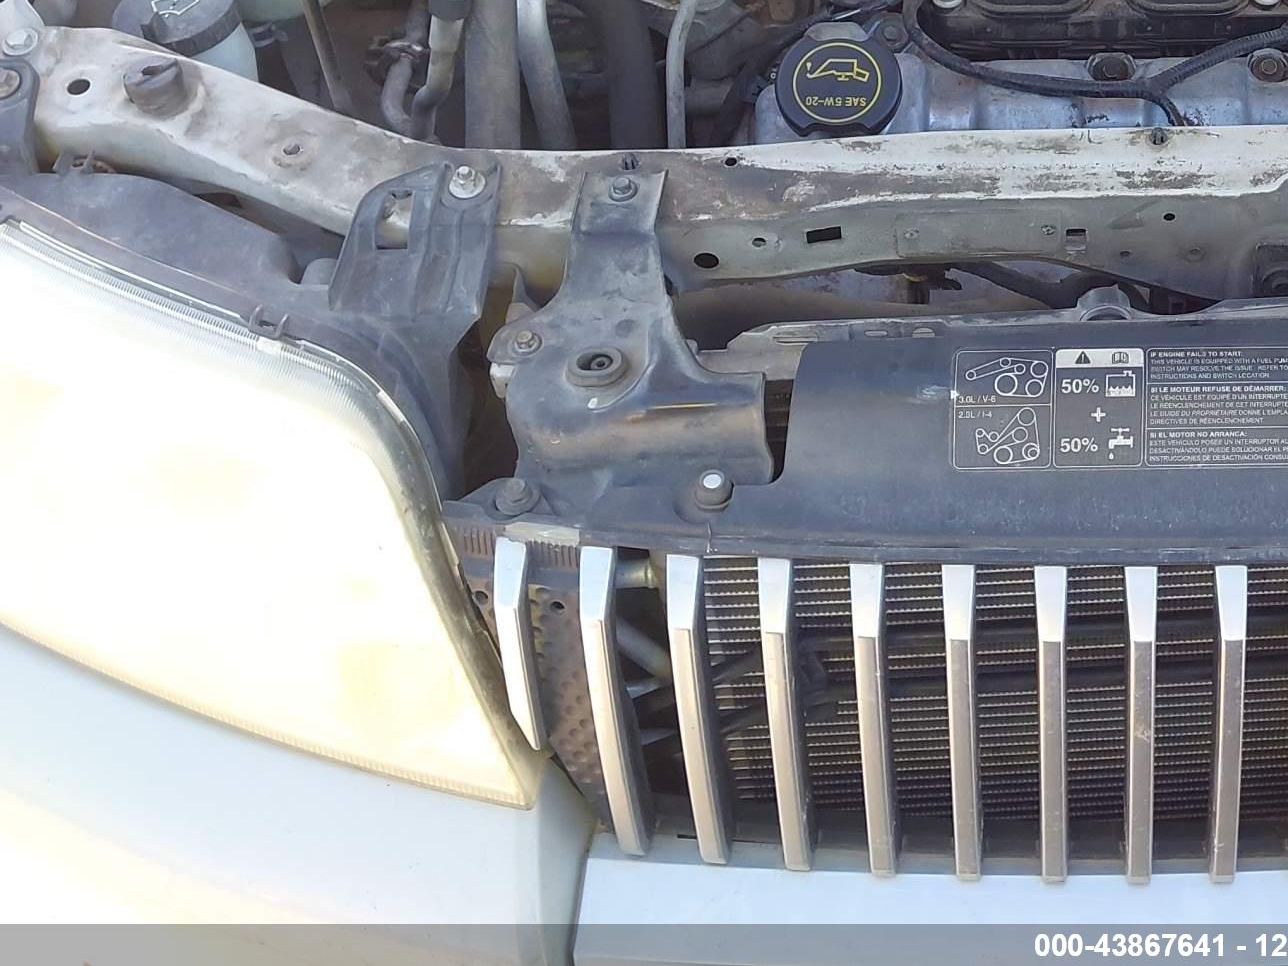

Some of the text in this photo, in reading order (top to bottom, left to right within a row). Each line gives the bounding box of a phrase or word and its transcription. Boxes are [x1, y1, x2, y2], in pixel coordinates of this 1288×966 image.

[806, 96, 867, 107] SAE 5W-20
[1061, 378, 1100, 394] 50%
[1060, 437, 1098, 452] 50%
